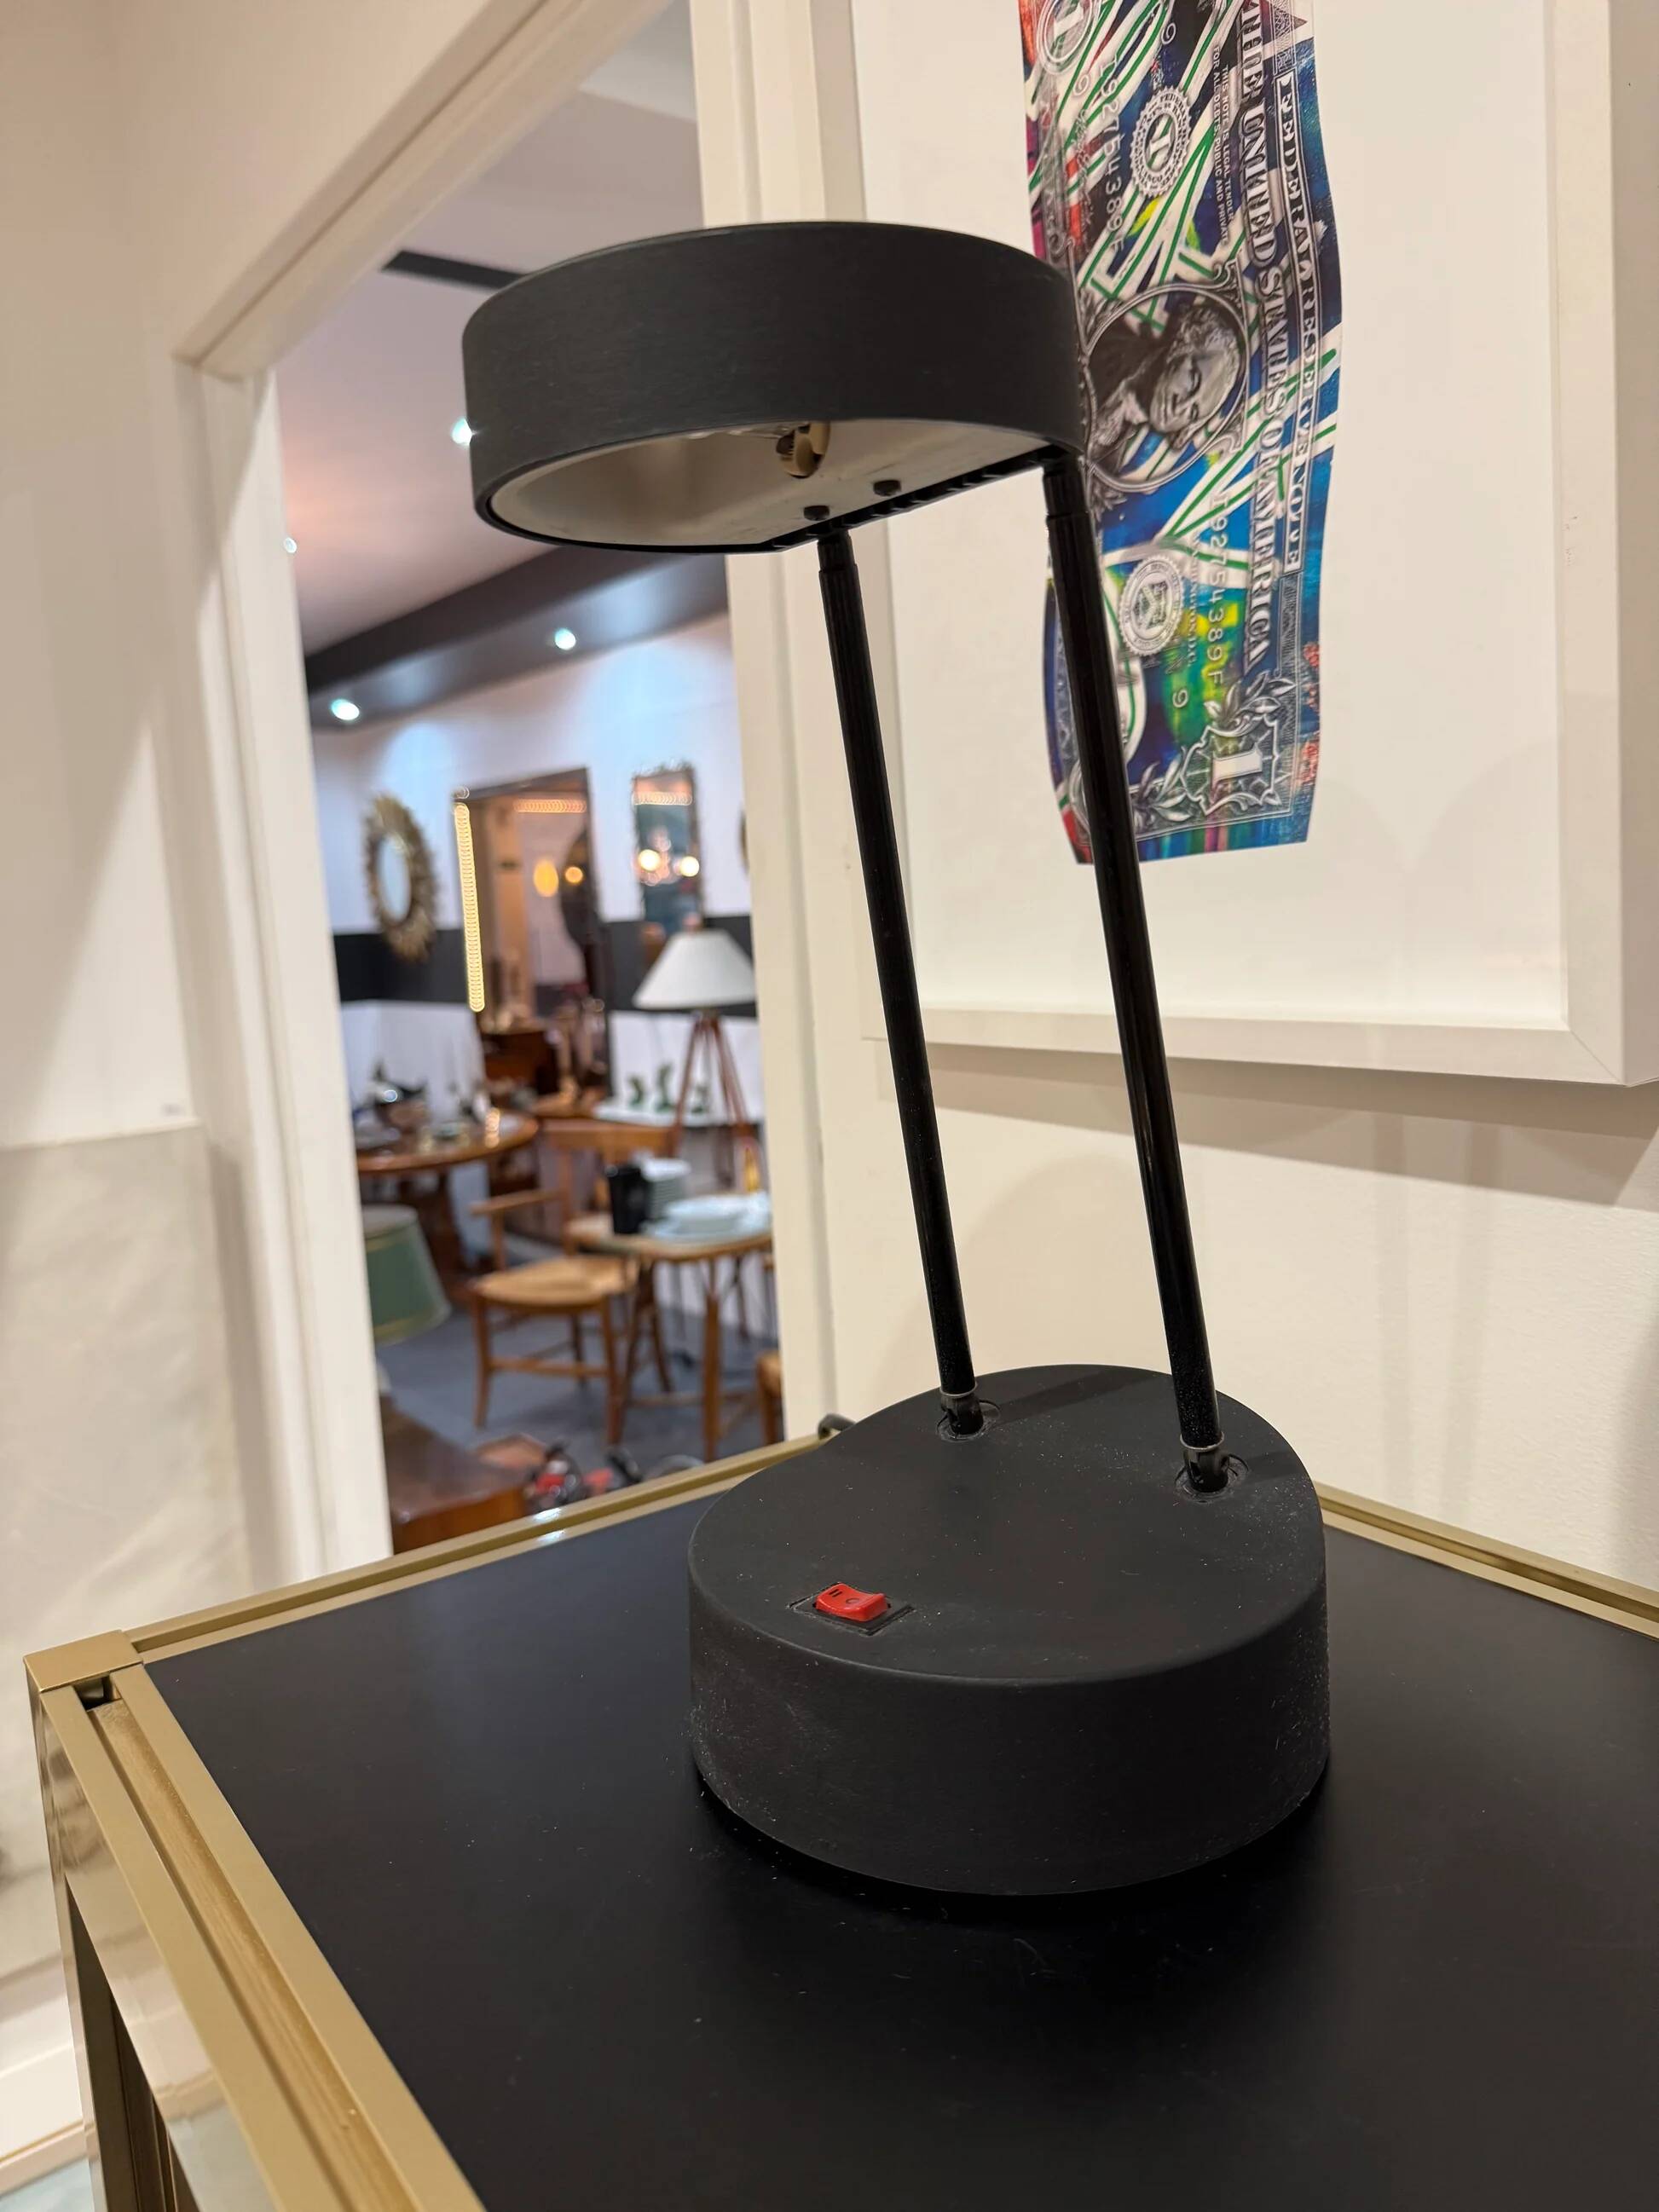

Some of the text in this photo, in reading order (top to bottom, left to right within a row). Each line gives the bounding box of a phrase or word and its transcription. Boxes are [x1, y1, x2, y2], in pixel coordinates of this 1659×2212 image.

[1223, 129, 1229, 141] IS
[1223, 144, 1231, 178] LEGAL
[1216, 180, 1224, 202] AND
[1224, 178, 1234, 221] TENDER
[1217, 205, 1229, 244] PRIVATE
[1241, 0, 1288, 662] THE UNITED STATES OF AMERICA
[1280, 78, 1316, 564] FEDERAL RESERVE NOTE
[1172, 689, 1188, 709] 9
